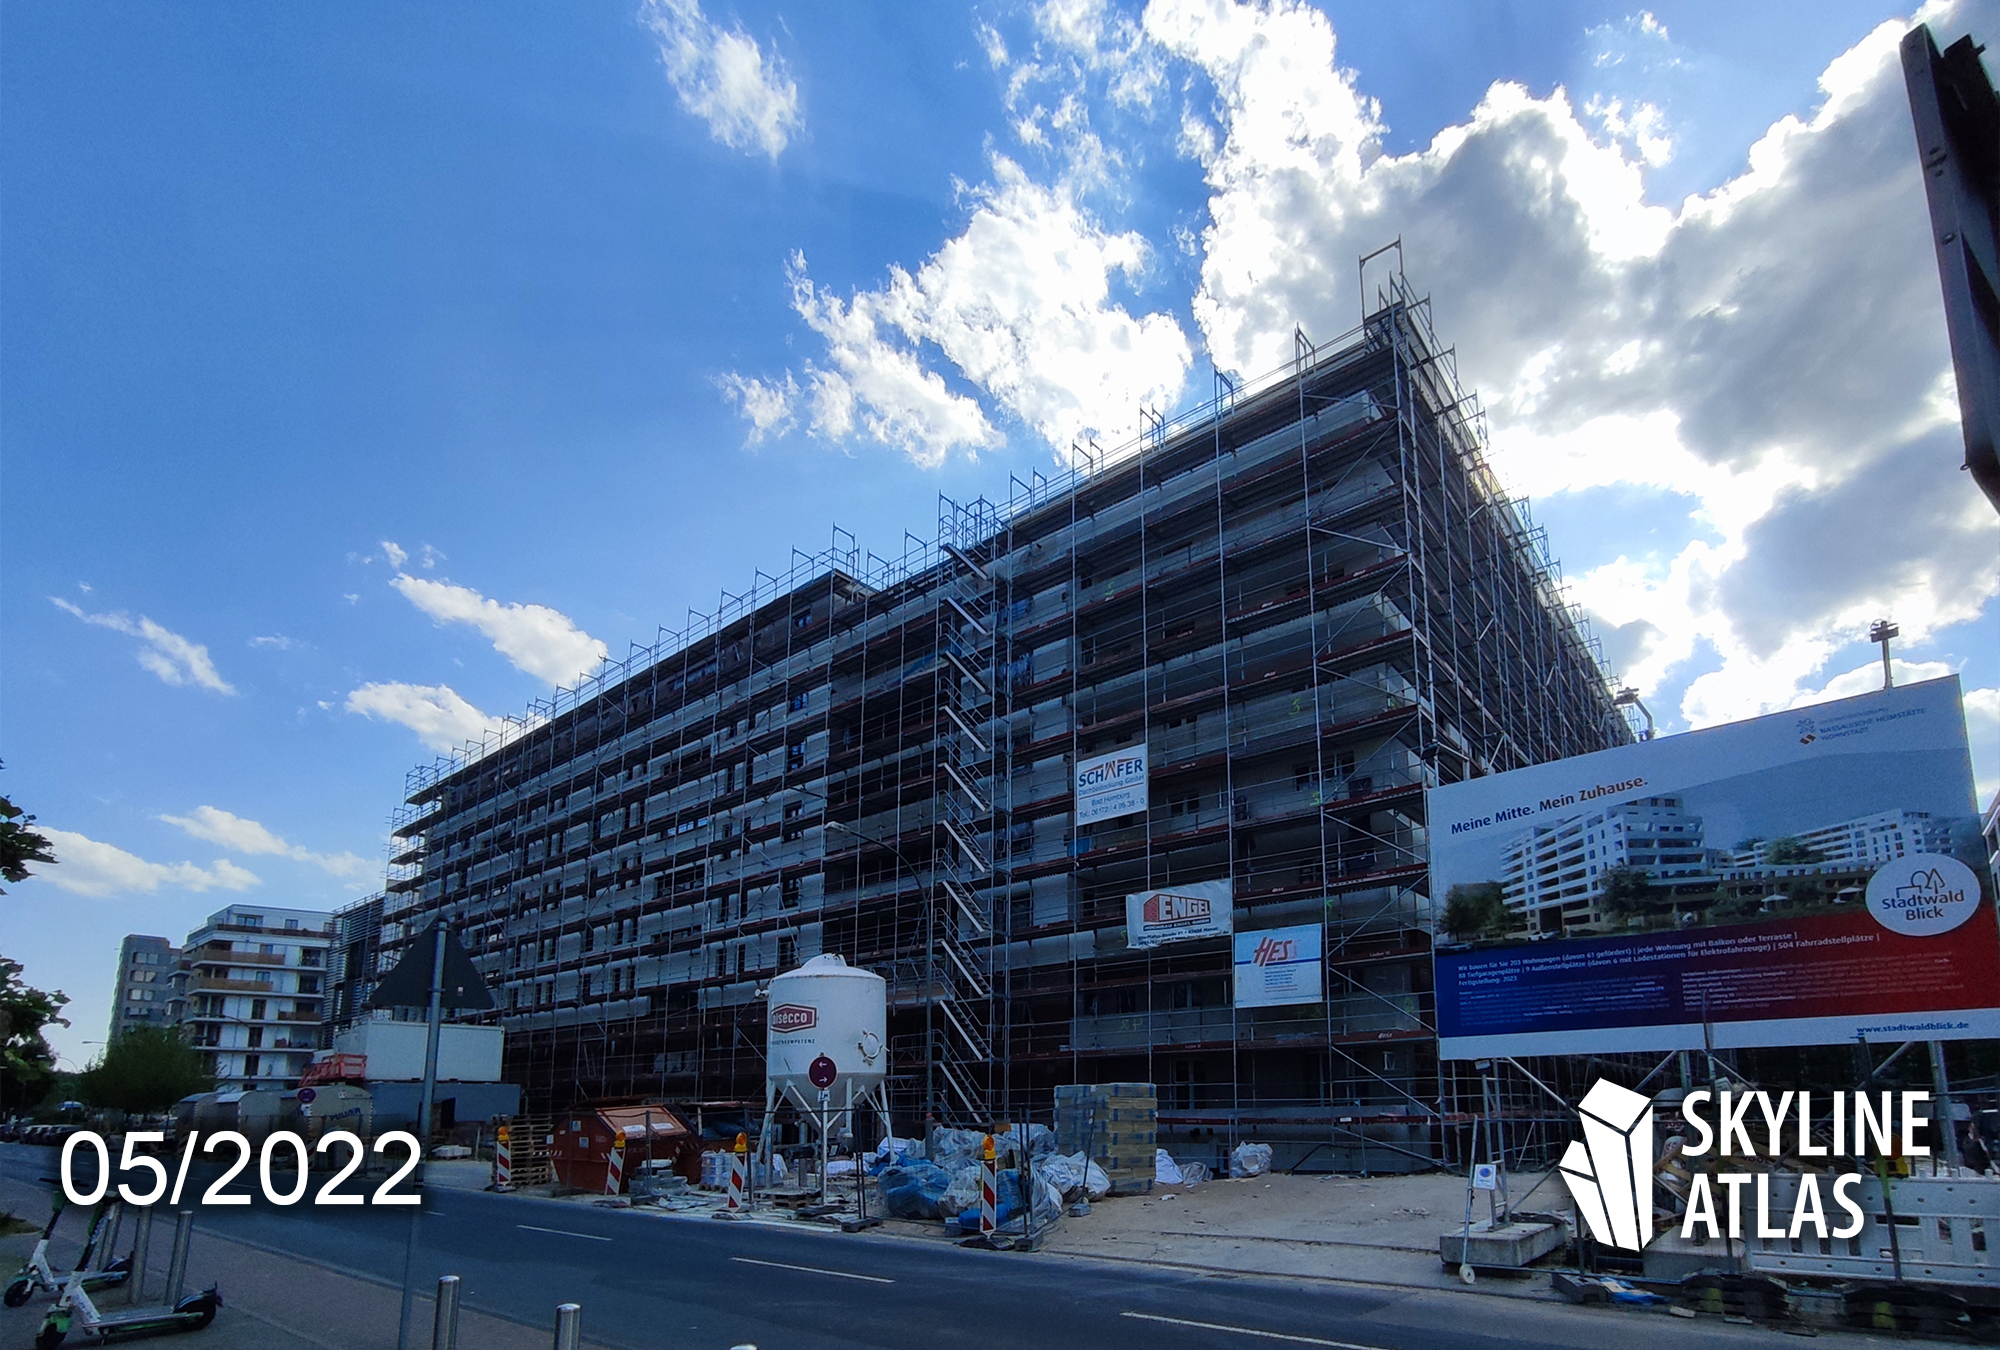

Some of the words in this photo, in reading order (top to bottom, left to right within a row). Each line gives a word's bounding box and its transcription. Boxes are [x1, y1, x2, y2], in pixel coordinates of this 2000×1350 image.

[1820, 719, 1873, 734] NASSAUISCHE
[1876, 707, 1926, 723] HEIMSTÄTTE
[1821, 727, 1869, 741] WOHNSTADT
[1125, 775, 1144, 785] GmbH
[1092, 796, 1103, 806] Bad
[1104, 792, 1130, 803] Homburg
[1451, 816, 1491, 835] Meine
[1495, 806, 1535, 824] Mitte.
[1539, 794, 1575, 812] Mein
[1579, 777, 1649, 802] Zuhause.
[1159, 894, 1210, 920] ENGEL
[1882, 889, 1965, 910] Stadtwald
[1906, 906, 1944, 921] Blick
[1467, 968, 1520, 978] Tiefgaragenplätze
[1531, 961, 1586, 972] Außenstellplätze
[1587, 959, 1611, 968] (davon
[1633, 952, 1686, 962] Ladestationen
[1688, 950, 1698, 958] für
[1701, 943, 1771, 956] Elektrofahrzeuge)
[1778, 941, 1794, 949] 504
[1796, 934, 1874, 948] Fahrradstellplätze
[1522, 955, 1561, 964] Wohnungen
[1562, 953, 1585, 962] (davon
[1596, 948, 1631, 958] gefördert)
[1637, 946, 1653, 955] jede
[1655, 942, 1691, 951] Wohnung
[1693, 940, 1706, 948] mit
[1708, 938, 1736, 946] Balkon
[1737, 936, 1756, 944] oder
[1758, 932, 1792, 942] Terrasse
[1857, 1022, 1969, 1033] www.stadtwaldblick.de
[329, 1107, 361, 1121] PULVER
